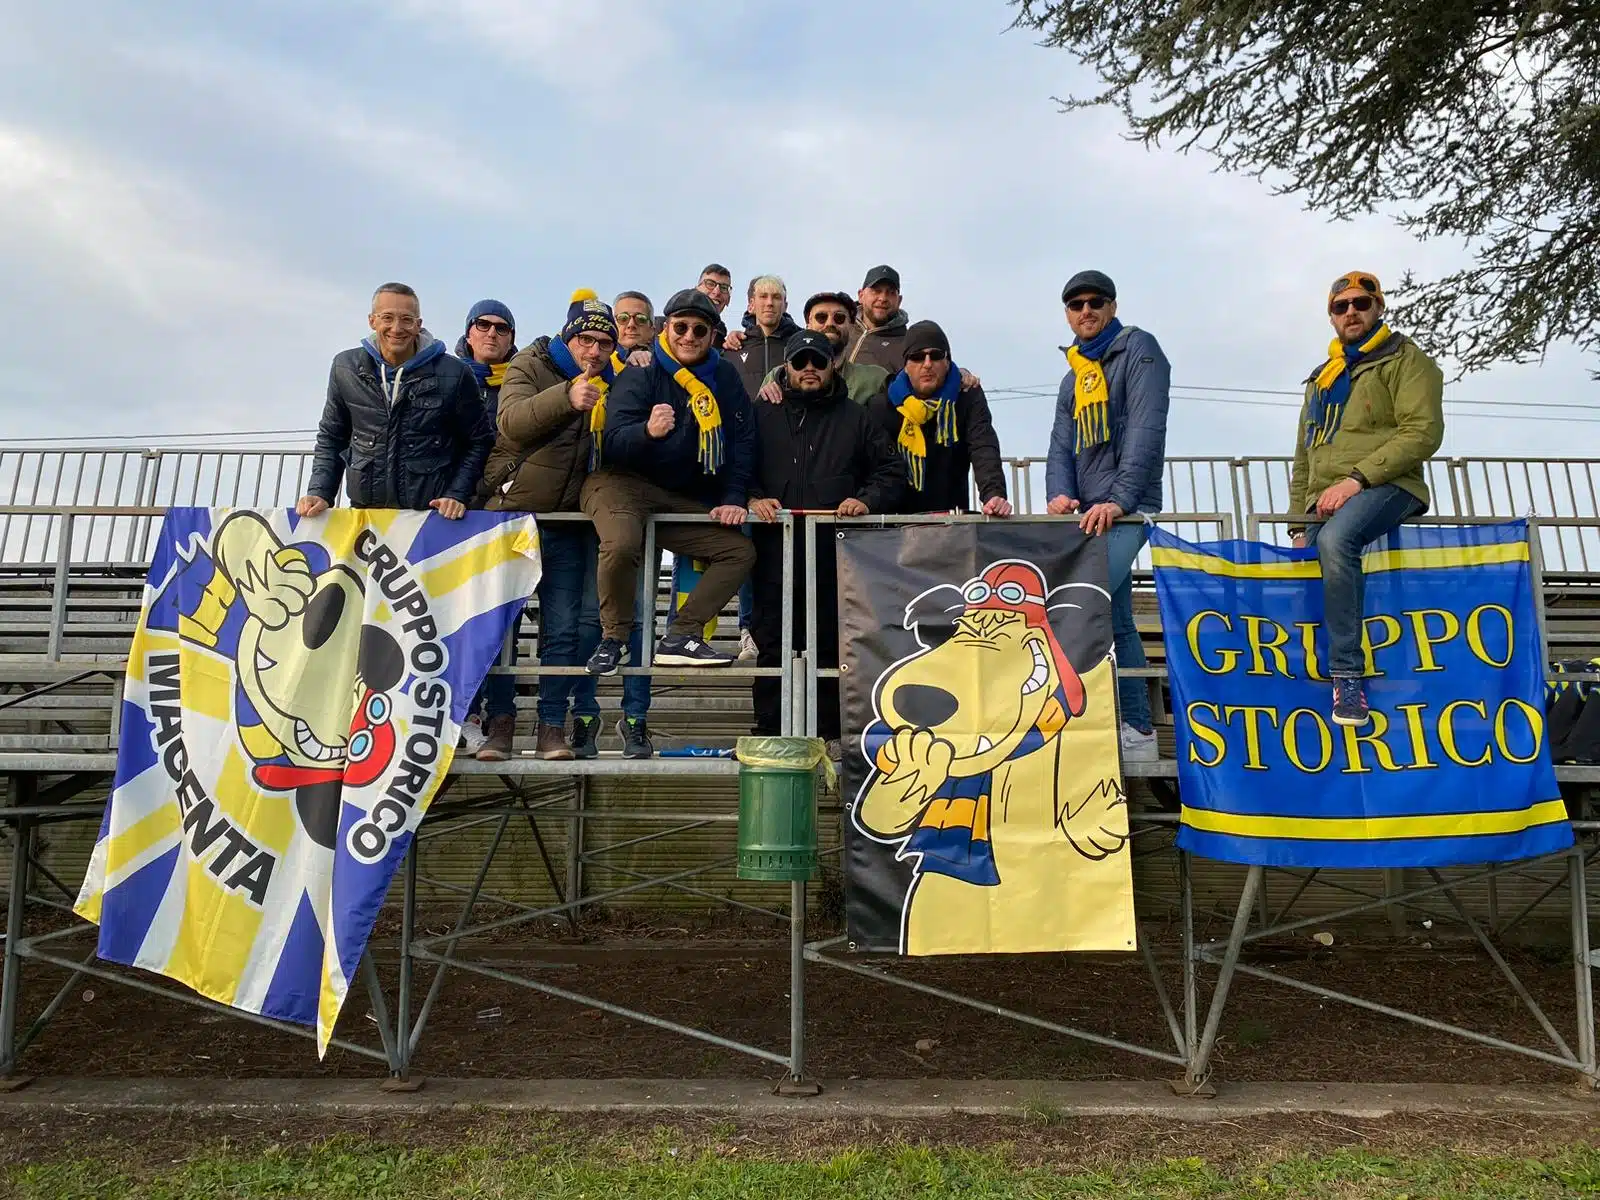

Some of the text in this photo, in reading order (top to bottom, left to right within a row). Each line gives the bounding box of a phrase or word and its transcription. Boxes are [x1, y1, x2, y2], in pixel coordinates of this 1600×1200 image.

[148, 653, 276, 906] MAGENTA
[351, 528, 447, 859] GRUPPO STORICO
[1187, 698, 1544, 774] STORICO
